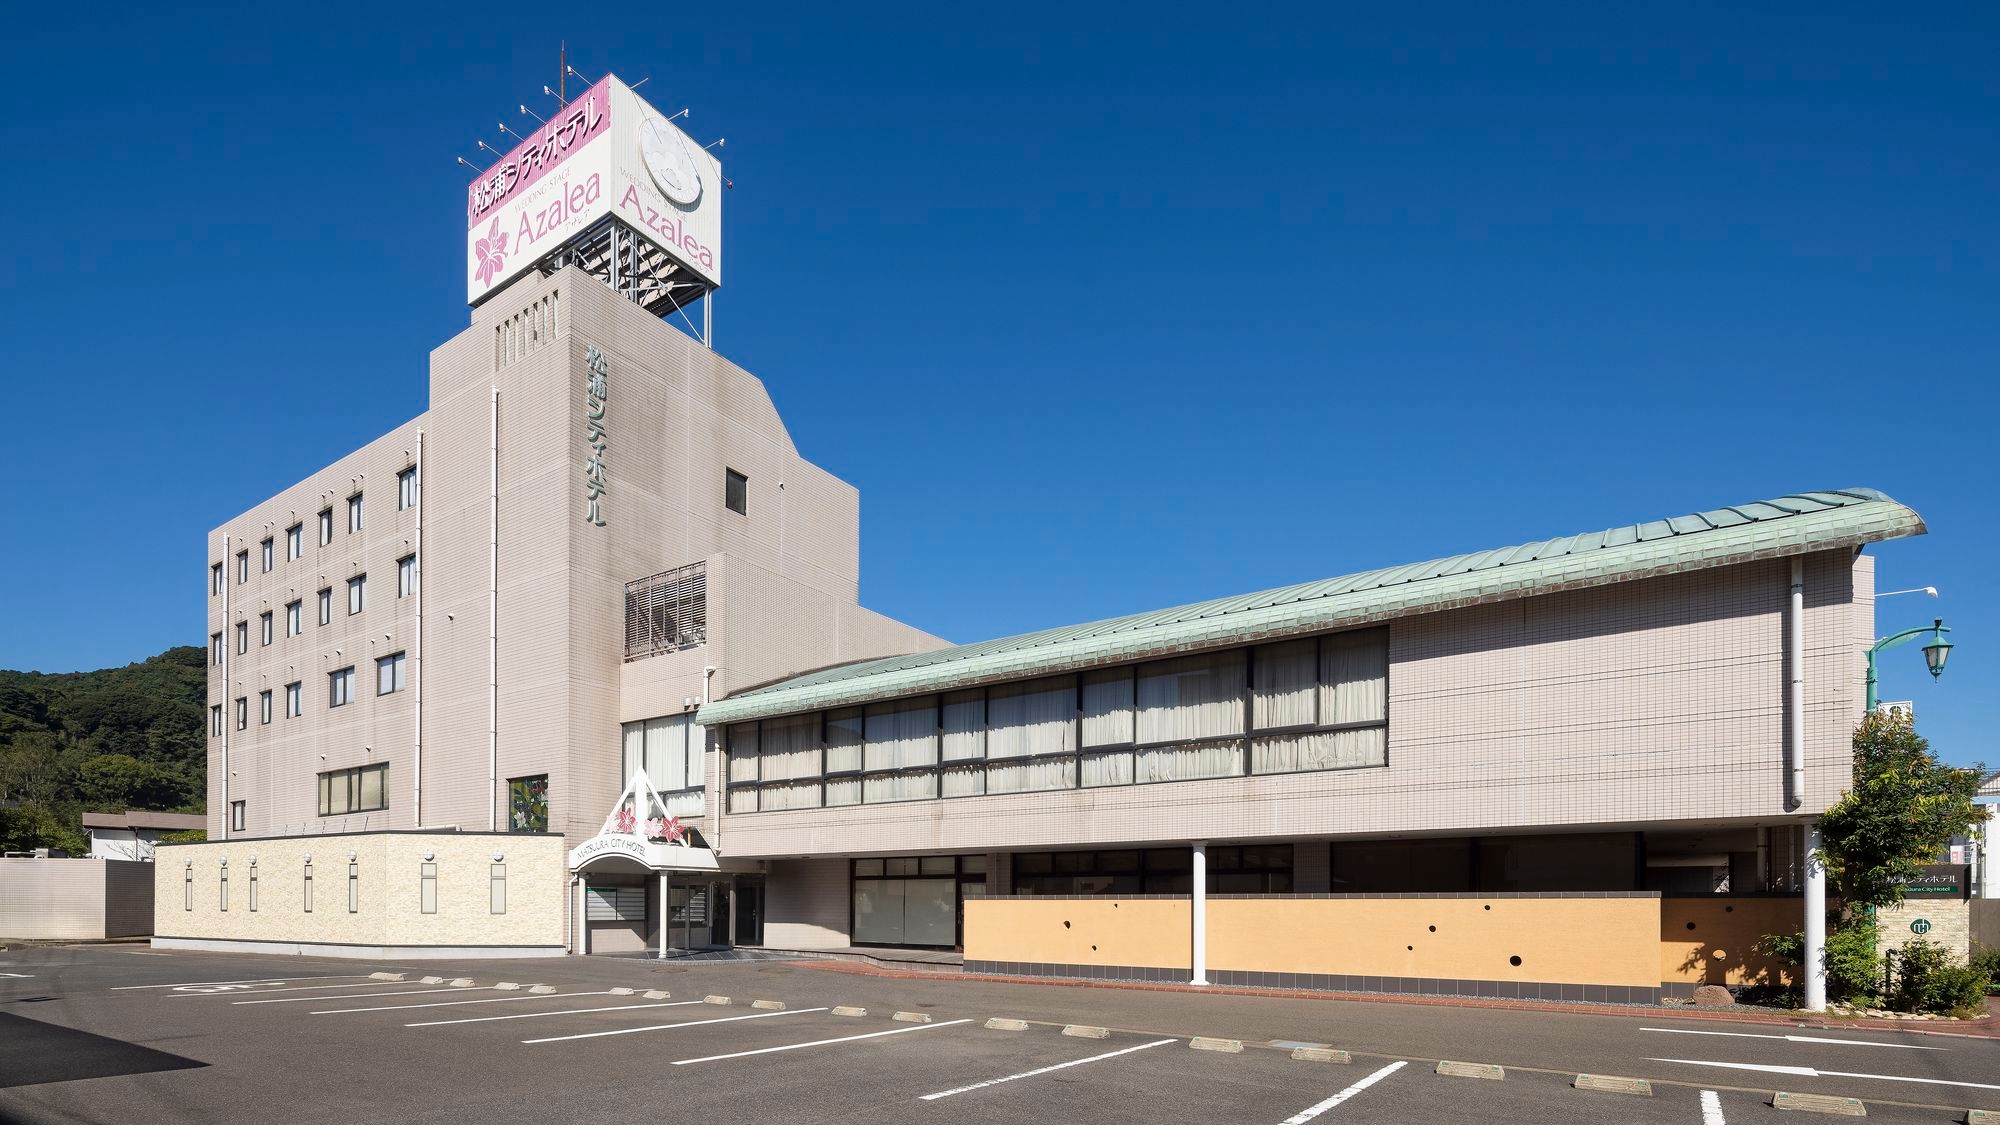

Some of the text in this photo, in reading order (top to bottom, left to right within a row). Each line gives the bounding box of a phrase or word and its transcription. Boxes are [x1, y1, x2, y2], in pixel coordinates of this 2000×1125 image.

[473, 96, 603, 218] 松浦シティホテル
[514, 167, 571, 213] WEDDING STAGE
[620, 167, 661, 202] WEDDING
[514, 172, 601, 256] Azalea
[619, 183, 713, 271] Azalea
[585, 345, 607, 527] 松浦シティホテル
[577, 838, 646, 859] MATSUURA CITY HOTEL
